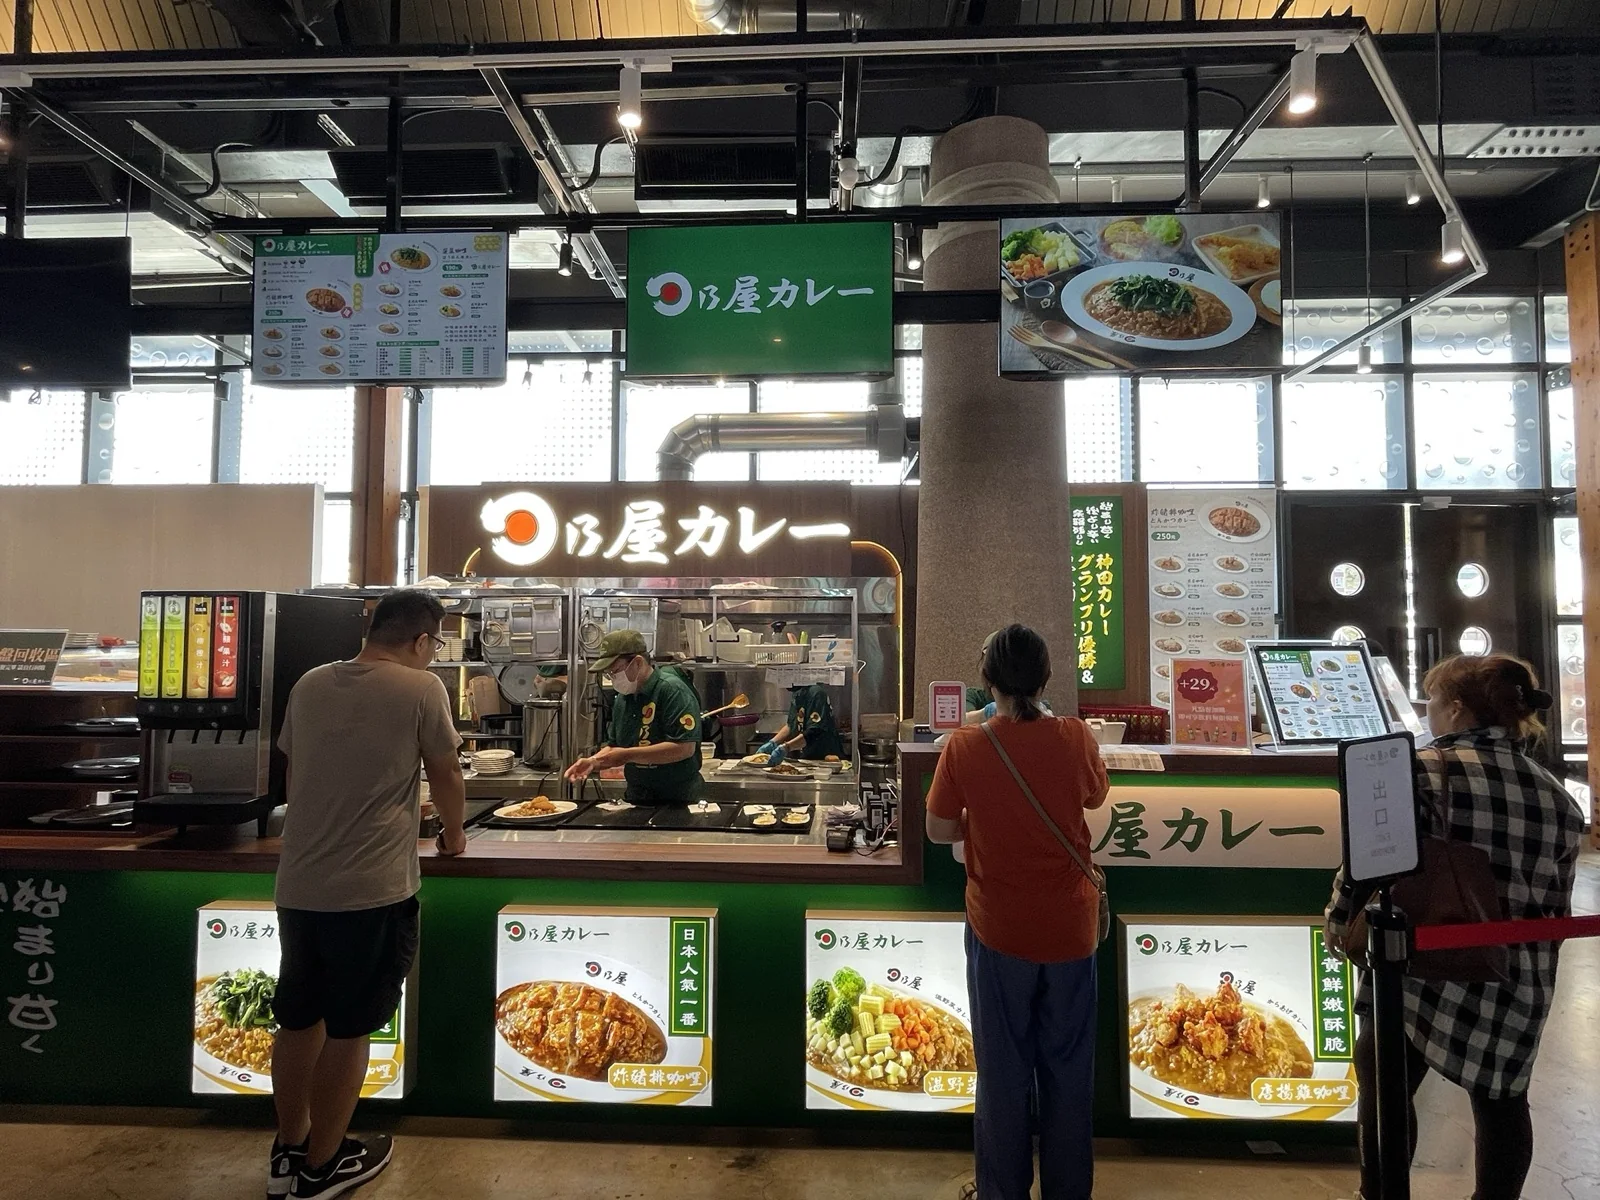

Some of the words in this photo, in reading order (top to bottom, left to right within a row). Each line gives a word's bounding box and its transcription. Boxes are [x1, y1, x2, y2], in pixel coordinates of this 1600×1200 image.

[699, 275, 875, 314] 乃屋カレー
[565, 500, 851, 564] 乃屋カレー
[1095, 553, 1114, 636] 神田カレー
[1091, 801, 1325, 860] 屋カレー
[230, 922, 276, 940] 乃屋カ
[528, 925, 610, 943] 乃屋カレー
[839, 932, 924, 951] 乃屋カレー
[1162, 937, 1249, 956] 乃屋カレー
[7, 878, 68, 1054] 始まり甘く
[603, 971, 629, 987] 乃屋
[679, 928, 699, 1027] 日本人氣一番
[901, 976, 923, 991] 乃屋
[1235, 979, 1257, 996] 乃屋
[1320, 941, 1348, 1053] 黃鮮嫩酥脆
